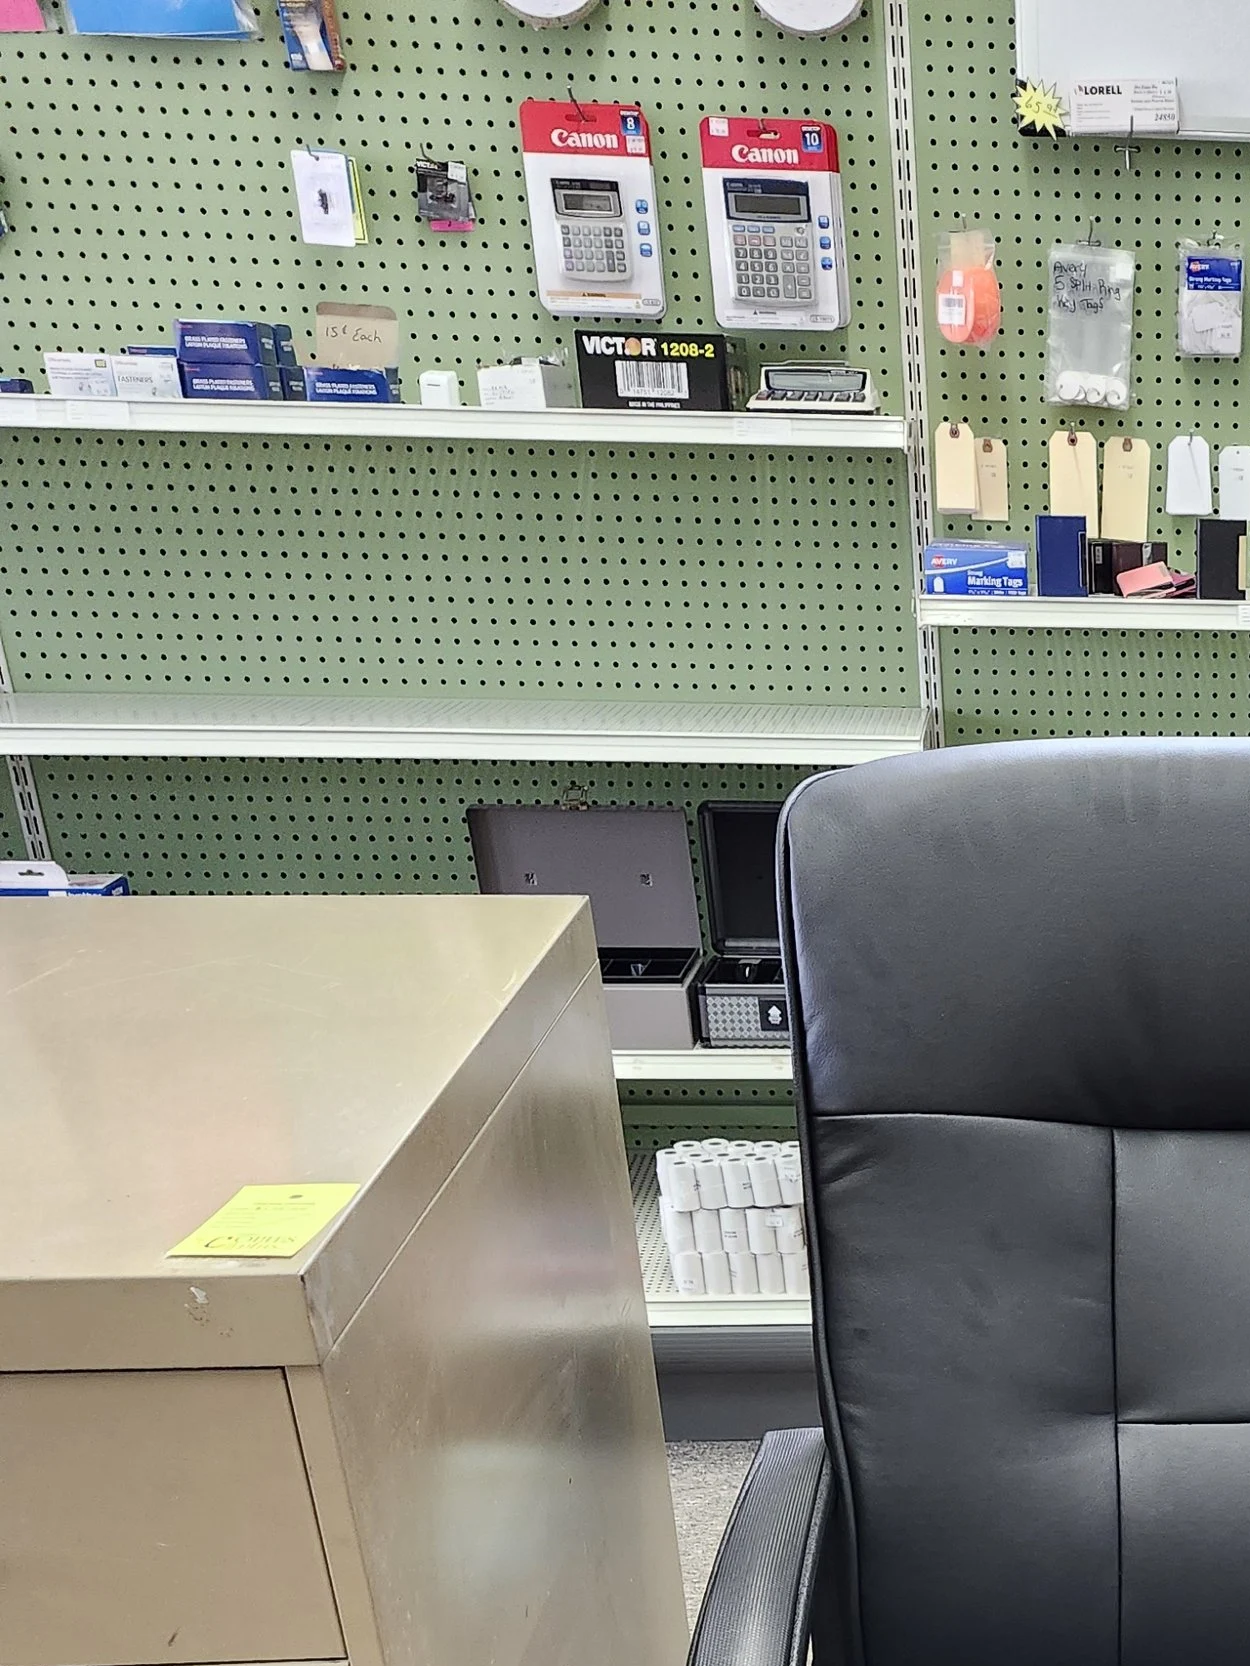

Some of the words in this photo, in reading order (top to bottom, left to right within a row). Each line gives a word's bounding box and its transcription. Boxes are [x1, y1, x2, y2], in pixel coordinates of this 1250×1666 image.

[1084, 85, 1122, 95] LORELL
[627, 117, 635, 130] 8
[551, 128, 619, 149] Canon
[805, 133, 820, 145] 10
[731, 144, 799, 164] Canon
[352, 327, 382, 343] Each
[582, 335, 656, 356] VICTOR
[661, 342, 715, 358] 1208-2
[931, 558, 958, 566] AVERY
[968, 576, 1002, 588] Marking
[1002, 576, 1023, 588] Tags
